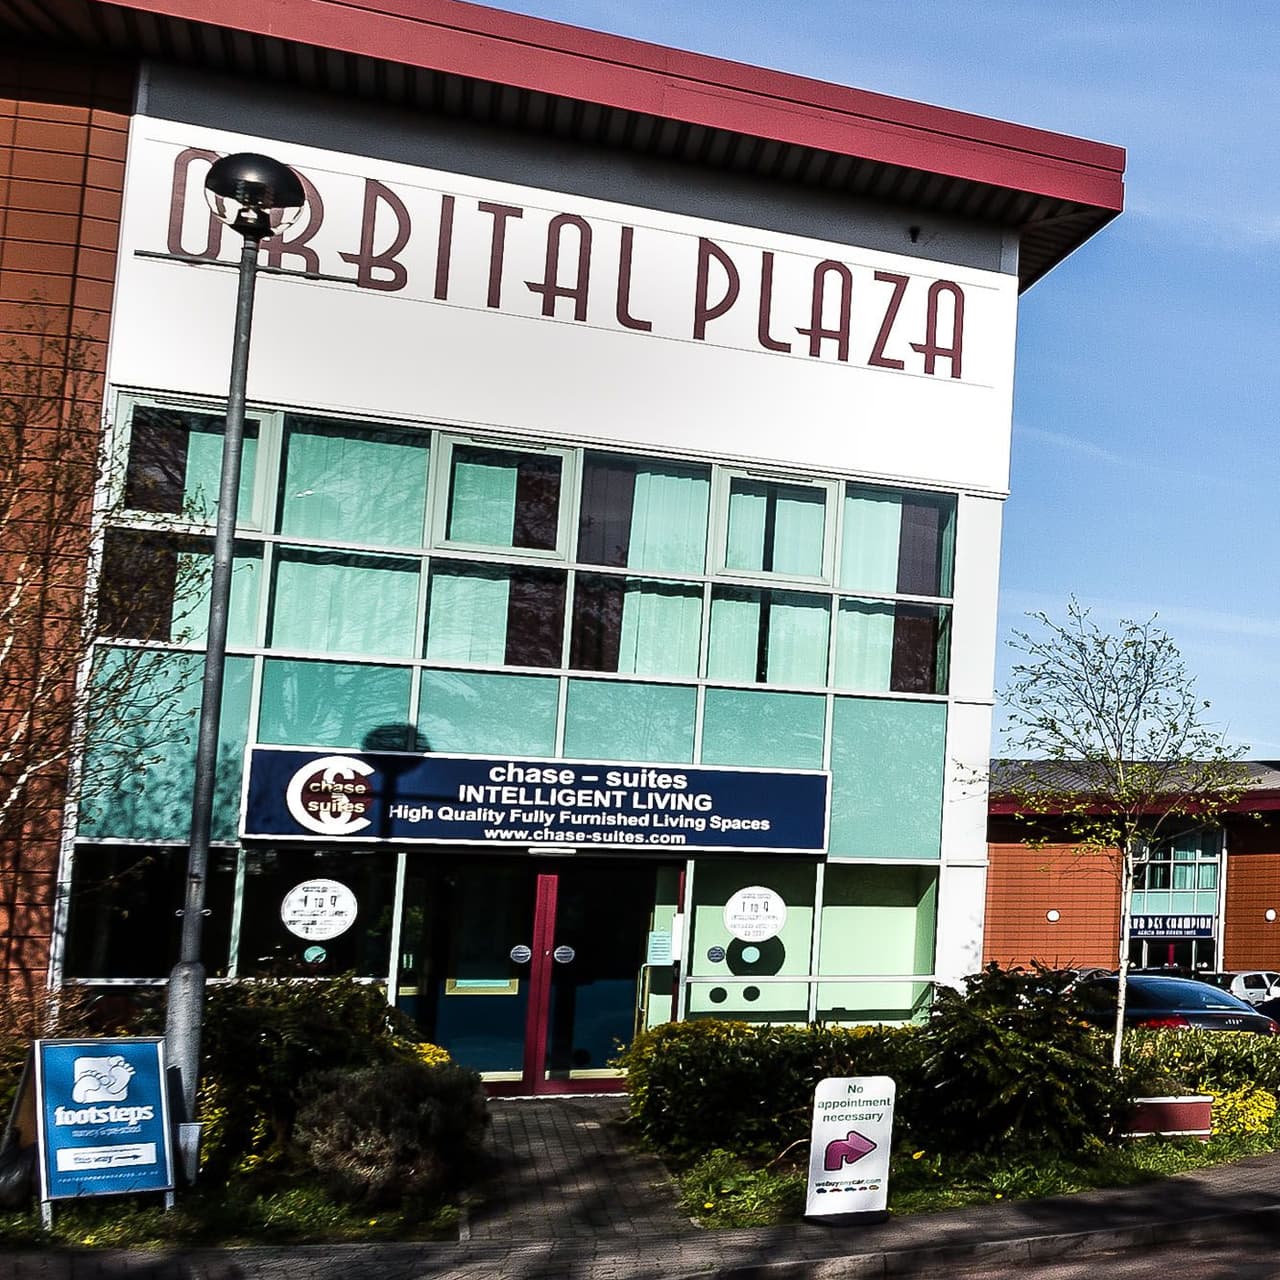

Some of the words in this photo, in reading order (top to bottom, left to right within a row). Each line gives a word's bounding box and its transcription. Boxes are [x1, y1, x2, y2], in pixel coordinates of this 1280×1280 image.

[167, 146, 653, 333] ORBITAL
[693, 236, 965, 379] PLAZA
[489, 762, 576, 785] chase
[606, 769, 688, 790] suites
[309, 780, 367, 795] chase
[308, 799, 366, 814] suites
[458, 784, 628, 809] INTELLIGENT
[632, 793, 713, 812] LIVING
[389, 804, 433, 823] High
[437, 806, 503, 825] Quality
[510, 809, 555, 827] Fully
[559, 811, 650, 828] Furnished
[653, 812, 706, 831] Living
[709, 815, 771, 832] Spaces
[484, 827, 687, 845] www.chase-suites.com
[847, 1084, 864, 1094] No
[817, 1097, 892, 1111] appointment
[54, 1104, 155, 1127] footsteps
[822, 1112, 884, 1123] necessary
